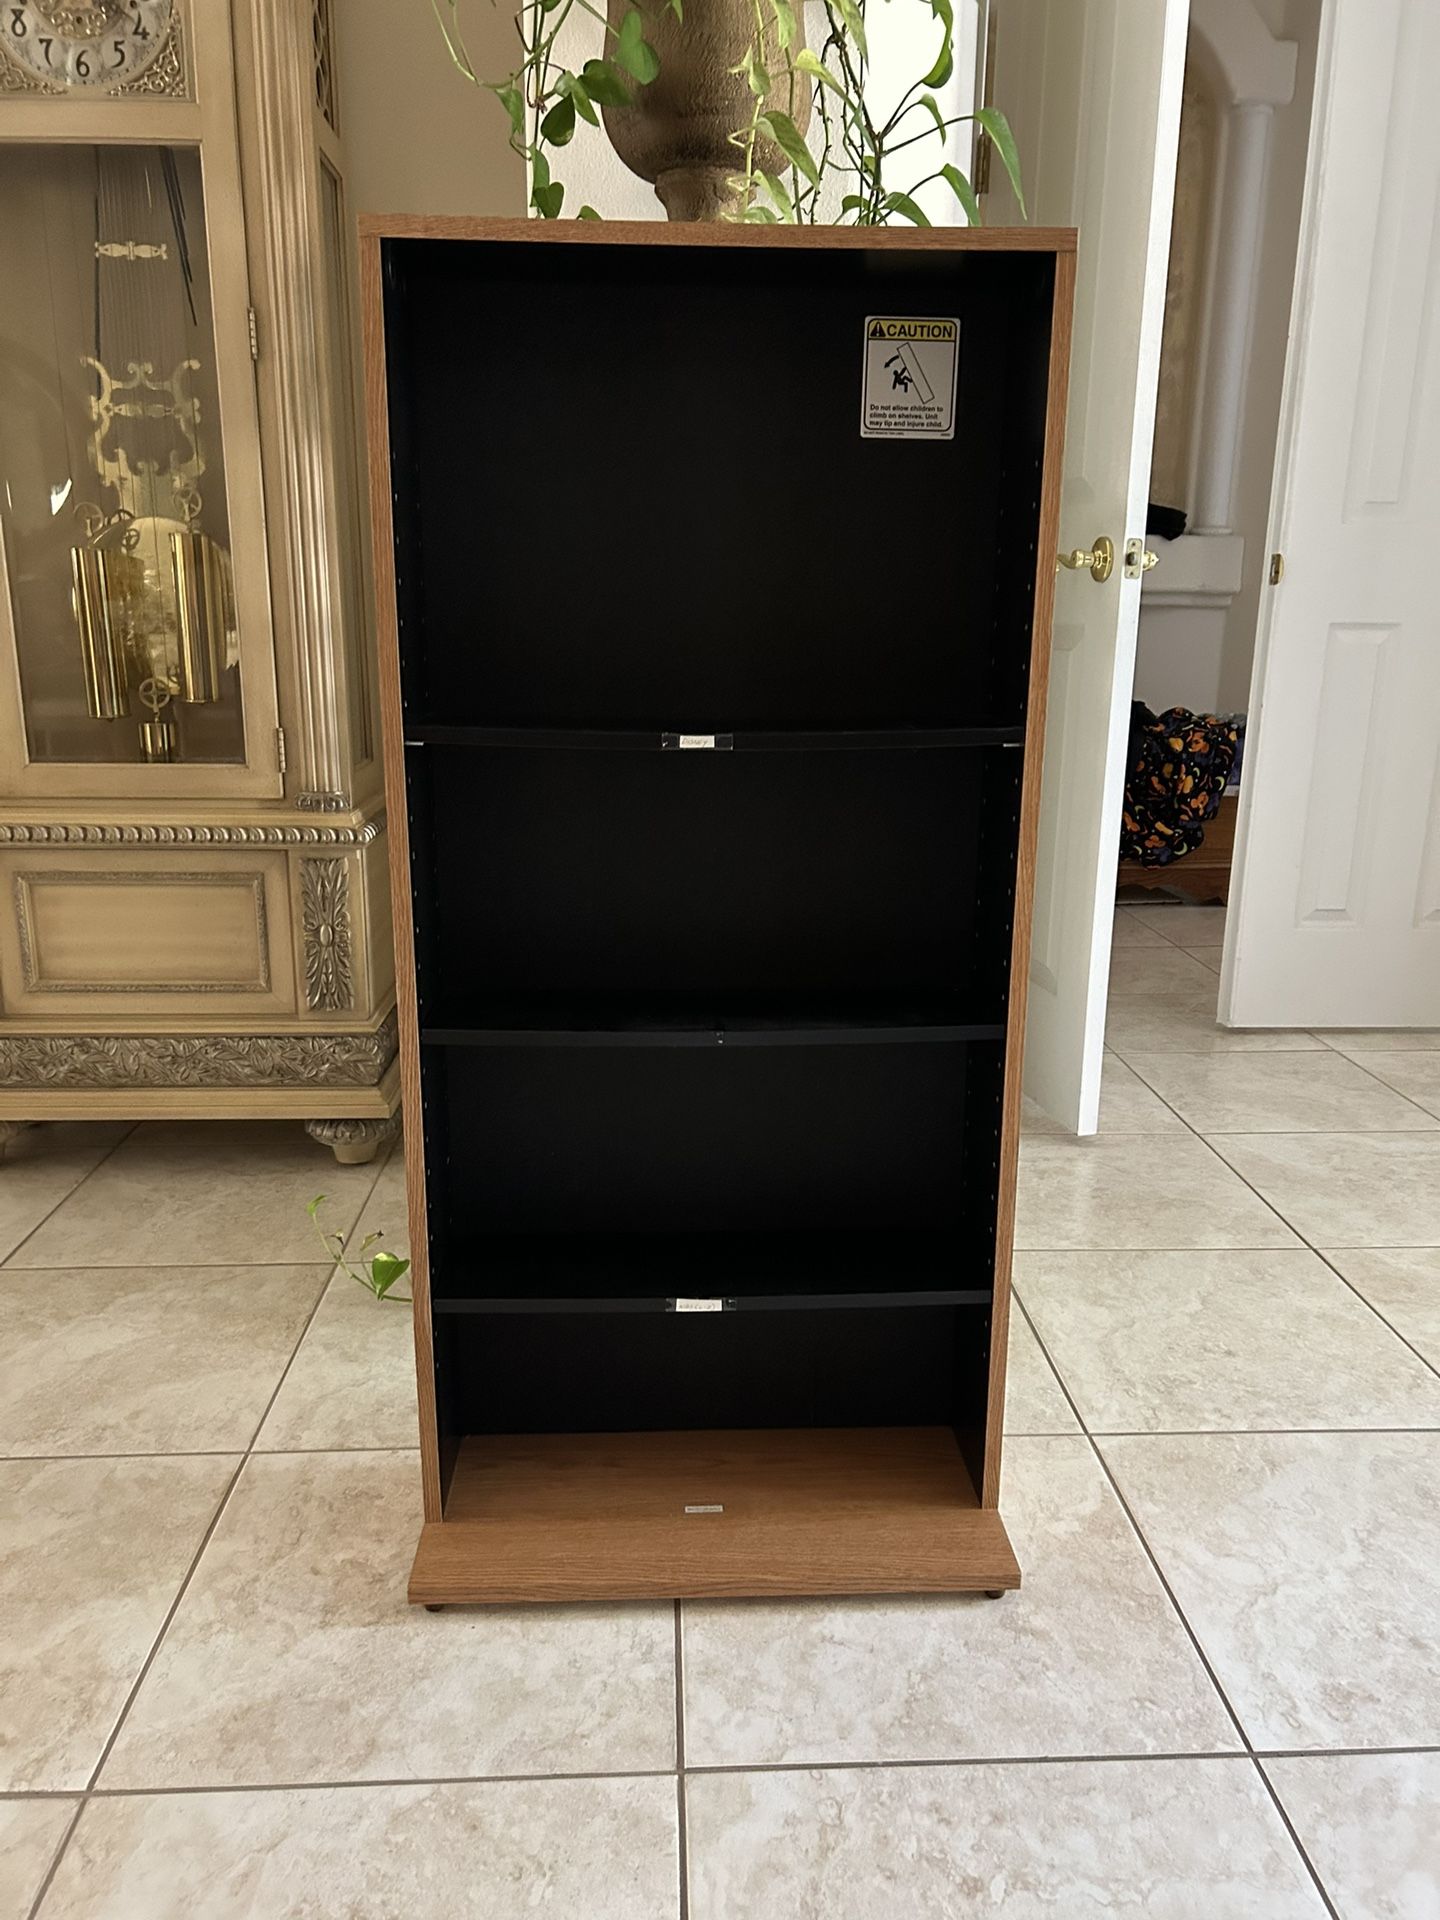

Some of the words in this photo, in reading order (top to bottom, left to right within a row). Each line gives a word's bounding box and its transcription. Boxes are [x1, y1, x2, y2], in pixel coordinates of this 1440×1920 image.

[11, 8, 27, 37] 8
[132, 10, 150, 40] 4
[38, 38, 53, 67] 7
[76, 50, 90, 77] 6
[111, 40, 125, 68] 5
[887, 324, 953, 338] CAUTION
[884, 420, 892, 428] tip
